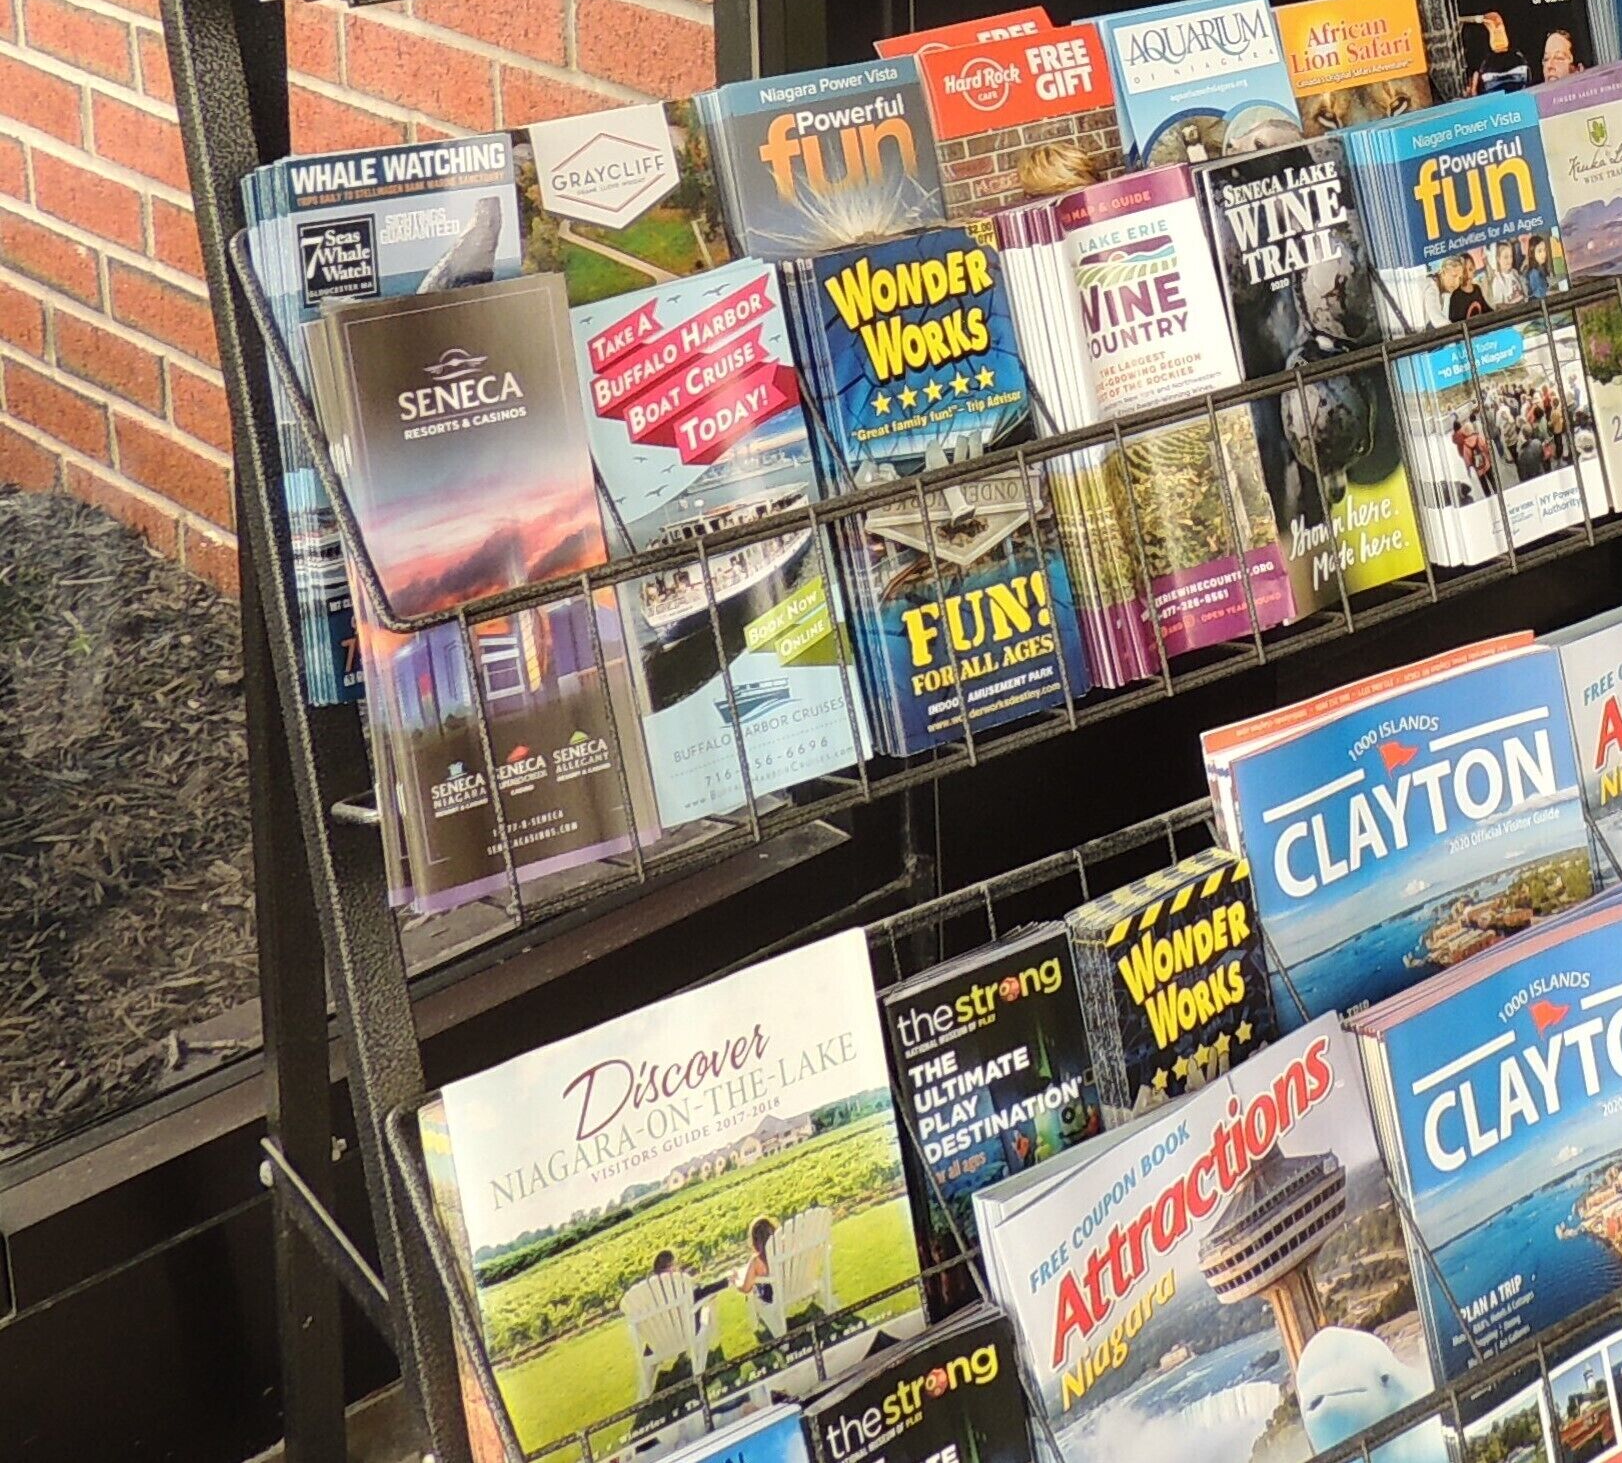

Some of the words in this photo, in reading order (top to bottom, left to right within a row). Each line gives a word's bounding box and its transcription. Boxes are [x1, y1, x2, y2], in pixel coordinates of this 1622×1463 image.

[1025, 39, 1090, 75] FREE
[1124, 8, 1269, 68] AQUARIUM
[1290, 49, 1343, 75] Lion
[1346, 35, 1411, 61] Safari
[1306, 17, 1388, 48] African
[1035, 66, 1093, 100] GIFT
[292, 159, 380, 195] WHALE
[386, 143, 506, 184] WATCHING
[1223, 176, 1282, 206] SENECA
[1285, 161, 1338, 189] LAKE
[1439, 137, 1523, 177] Powerful
[1224, 179, 1349, 254] WINE
[1413, 154, 1537, 242] fun
[1242, 233, 1343, 287] TRAIL
[592, 327, 635, 361] TAKE
[637, 316, 653, 336] A
[595, 346, 678, 407] BUFFALO
[681, 293, 763, 348] HARBOR
[398, 371, 524, 421] SENECA
[629, 397, 681, 436] BOAT
[686, 342, 755, 394] CRUISE
[680, 385, 769, 450] TODAY!
[404, 420, 460, 440] RESORTS
[462, 418, 471, 428] &
[472, 406, 527, 426] CASINOS
[1348, 730, 1378, 762] 1000
[1379, 715, 1440, 739] ISLANDS
[1270, 729, 1557, 900] CLAYTON
[1449, 836, 1470, 856] 2020
[1471, 824, 1502, 847] Official
[1503, 816, 1532, 834] Visitor
[1533, 807, 1560, 825] Guide
[562, 1018, 771, 1143] Discover
[489, 1031, 858, 1213] NIAGARA-ON-THE-LAKE
[590, 1148, 658, 1183] VISITORS
[663, 1126, 711, 1152] GUIDE
[715, 1096, 780, 1132] 2017-2018
[1030, 1241, 1069, 1294] FREE
[1072, 1167, 1136, 1250] COUPON
[1140, 1120, 1190, 1178] BOOK
[1050, 1035, 1333, 1367] Attractions
[1060, 1270, 1177, 1412] Niagara
